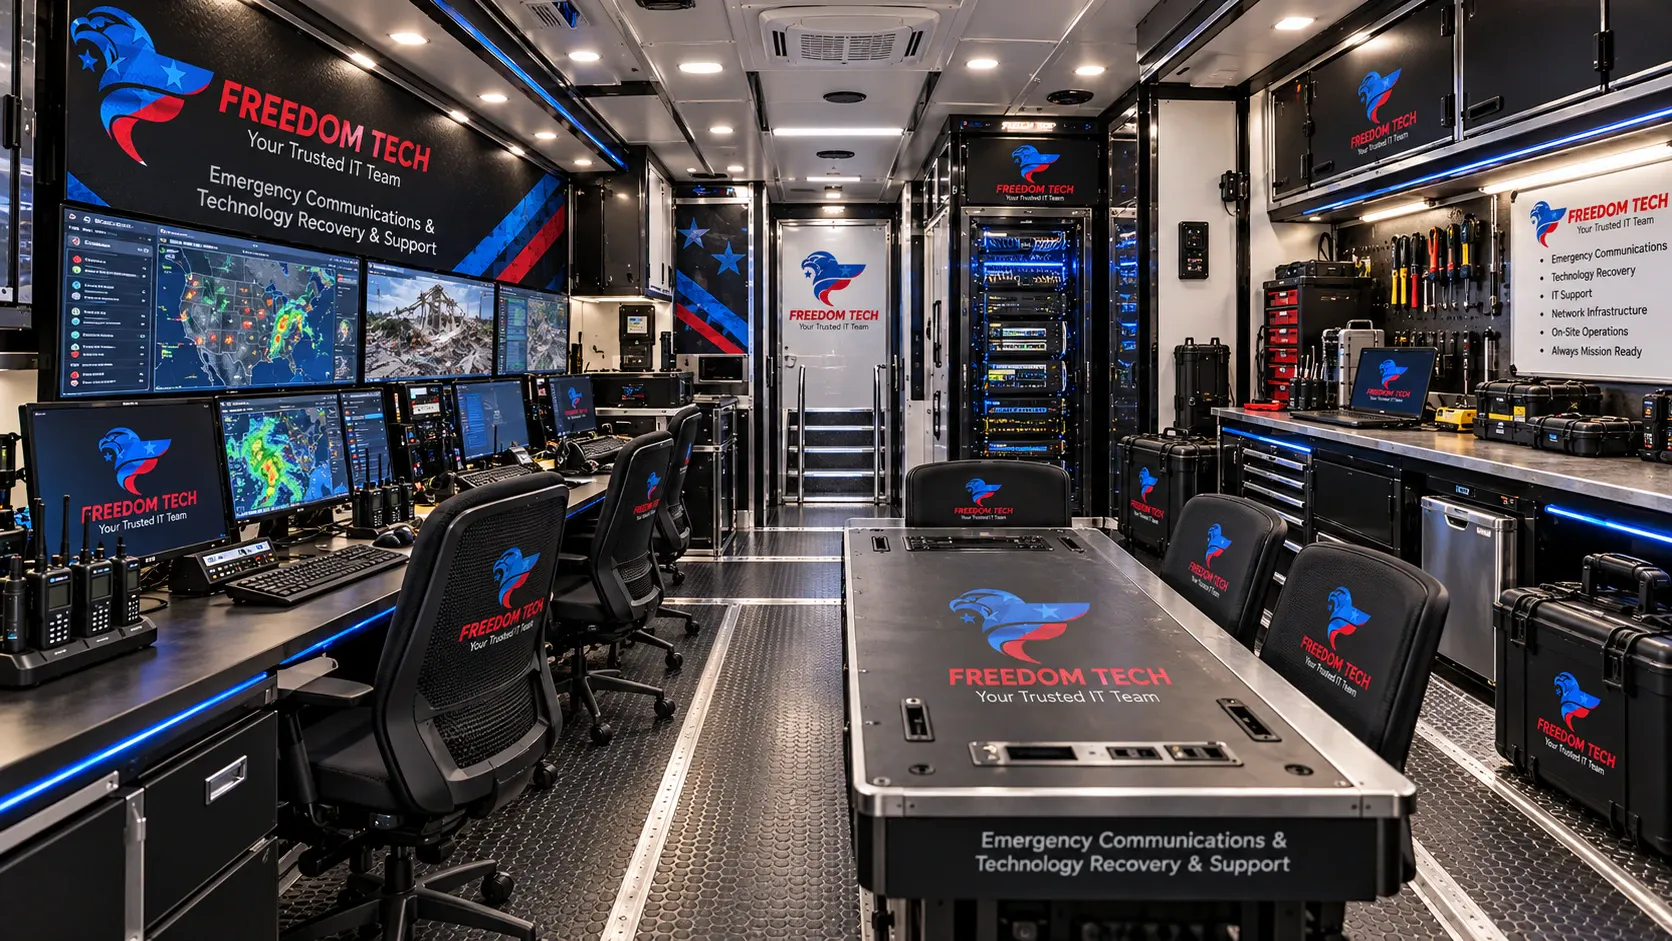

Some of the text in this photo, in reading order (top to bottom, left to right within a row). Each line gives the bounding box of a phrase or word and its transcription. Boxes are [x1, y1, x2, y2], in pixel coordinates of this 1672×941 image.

[219, 80, 431, 172] FREEDOM TECH
[1351, 111, 1417, 149] FREEDOM TECH
[1358, 147, 1368, 155] Your
[1388, 136, 1393, 144] IT
[1394, 132, 1409, 141] Team
[248, 130, 400, 187] Your Trusted IT Team
[210, 165, 435, 234] Emergency Communications &
[996, 184, 1075, 194] FREEDOM TECH
[1568, 193, 1669, 224] FREEDOM TECH
[197, 188, 437, 256] Technology Recovery & Support
[1577, 216, 1654, 234] Your Trusted IT Team
[1552, 242, 1668, 264] Emergency Communications
[1552, 267, 1636, 282] Technology Recovery
[1552, 289, 1592, 301] IT Support
[789, 310, 879, 321] FREEDOM TECH
[1552, 306, 1648, 318] Network Infrastructure
[1552, 326, 1629, 338] On-Site Operations
[1552, 346, 1642, 359] Always Mission Ready
[82, 490, 197, 524] FREEDOM TECH
[99, 512, 188, 534] Your Trusted IT Team
[458, 597, 545, 642] FREEDOM TECH
[470, 640, 488, 652] Your
[1300, 635, 1372, 690] FREEDOM TECH
[949, 668, 1173, 686] FREEDOM TECH
[1305, 656, 1357, 697] Your Trusted IT Team
[976, 691, 1161, 703] Your Trusted IT Team
[1537, 717, 1616, 768] FREEDOM TECH
[1545, 737, 1558, 750] Your
[1581, 756, 1587, 766] IT
[1589, 760, 1605, 776] Team
[982, 832, 1287, 852] Emergency Communications &
[976, 855, 1291, 876] Technology Recovery & Support
